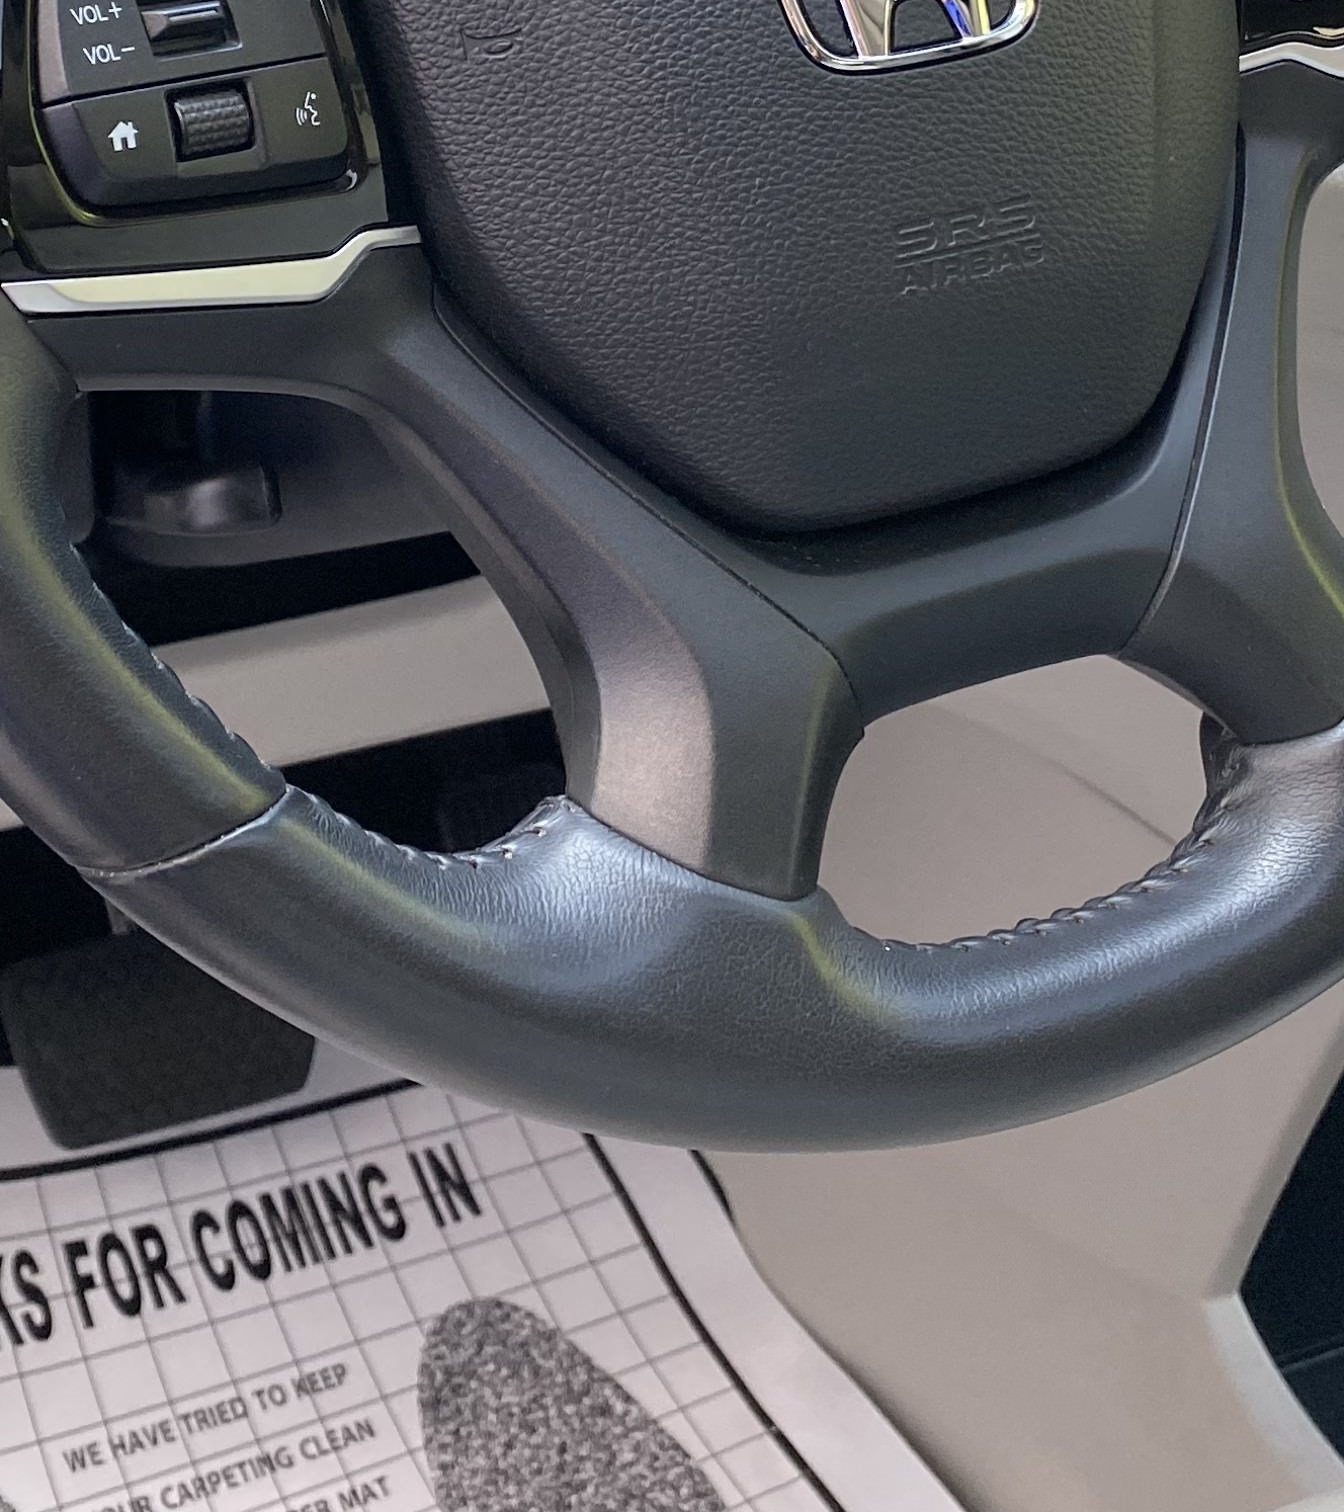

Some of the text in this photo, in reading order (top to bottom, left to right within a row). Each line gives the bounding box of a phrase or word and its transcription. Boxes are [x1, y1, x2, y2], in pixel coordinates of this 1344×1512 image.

[70, 1, 123, 26] VOL+
[63, 1224, 187, 1329] FOR
[190, 1163, 407, 1291] COMING
[409, 1141, 484, 1229] IN
[63, 1363, 347, 1473] WE HAVE TRIED TO KEEP
[160, 1446, 294, 1510] CARPETING
[299, 1420, 376, 1460] CLEAN
[338, 1475, 392, 1511] MAT
